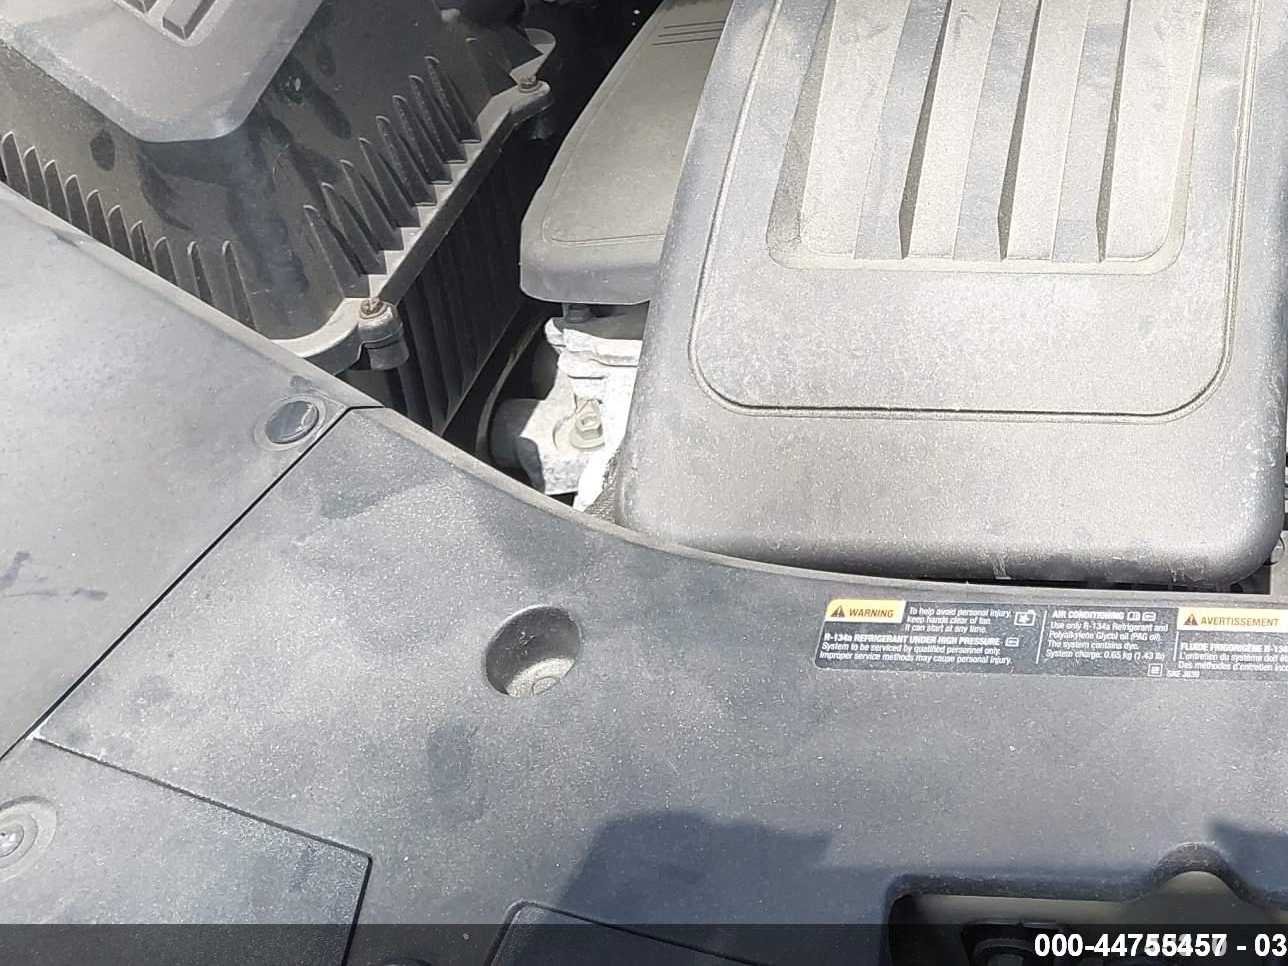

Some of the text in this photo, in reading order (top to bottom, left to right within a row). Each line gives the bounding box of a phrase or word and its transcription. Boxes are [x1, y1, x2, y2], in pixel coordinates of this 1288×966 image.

[849, 609, 894, 618] WARNING
[909, 607, 918, 615] To
[919, 607, 935, 617] help
[936, 608, 956, 616] avoid
[957, 608, 989, 618] personal
[1051, 610, 1125, 620] AIR CONDITIONING
[907, 615, 925, 624] keep
[926, 616, 949, 624] hands
[949, 616, 969, 624] clear
[969, 616, 978, 624] of
[1200, 616, 1280, 627] AVERTISSEMENT
[904, 624, 910, 632] It
[911, 624, 926, 632] can
[927, 624, 944, 632] start
[954, 625, 968, 634] any
[1050, 621, 1169, 632] Use only R-134a Refrigerant and
[824, 633, 1001, 646] R-134a REFRIGERANT UNDER HIGH PRESSURE
[1048, 631, 1095, 640] Polyalkylene
[1096, 631, 1119, 641] Glycol
[1120, 632, 1129, 640] oil
[1130, 632, 1148, 641] (PAG
[822, 642, 1001, 657] System to be serviced by qualified personnel only.
[1048, 639, 1139, 651] The system contains dye.
[1180, 642, 1209, 651] FLUIDE
[819, 651, 854, 660] Improper
[854, 652, 881, 660] service
[882, 653, 914, 662] methods
[915, 655, 932, 664] may
[933, 655, 956, 663] cause
[956, 655, 989, 664] personal
[1045, 649, 1165, 662] System charge: 0.65 kg (1.43 lb)
[1179, 651, 1218, 661] L'entretien
[1220, 653, 1230, 661] du
[1264, 653, 1278, 662] doit
[1178, 661, 1194, 669] Des
[1194, 661, 1232, 670] méthodes
[1233, 662, 1273, 671] d'entretien
[1167, 670, 1182, 678] SAE
